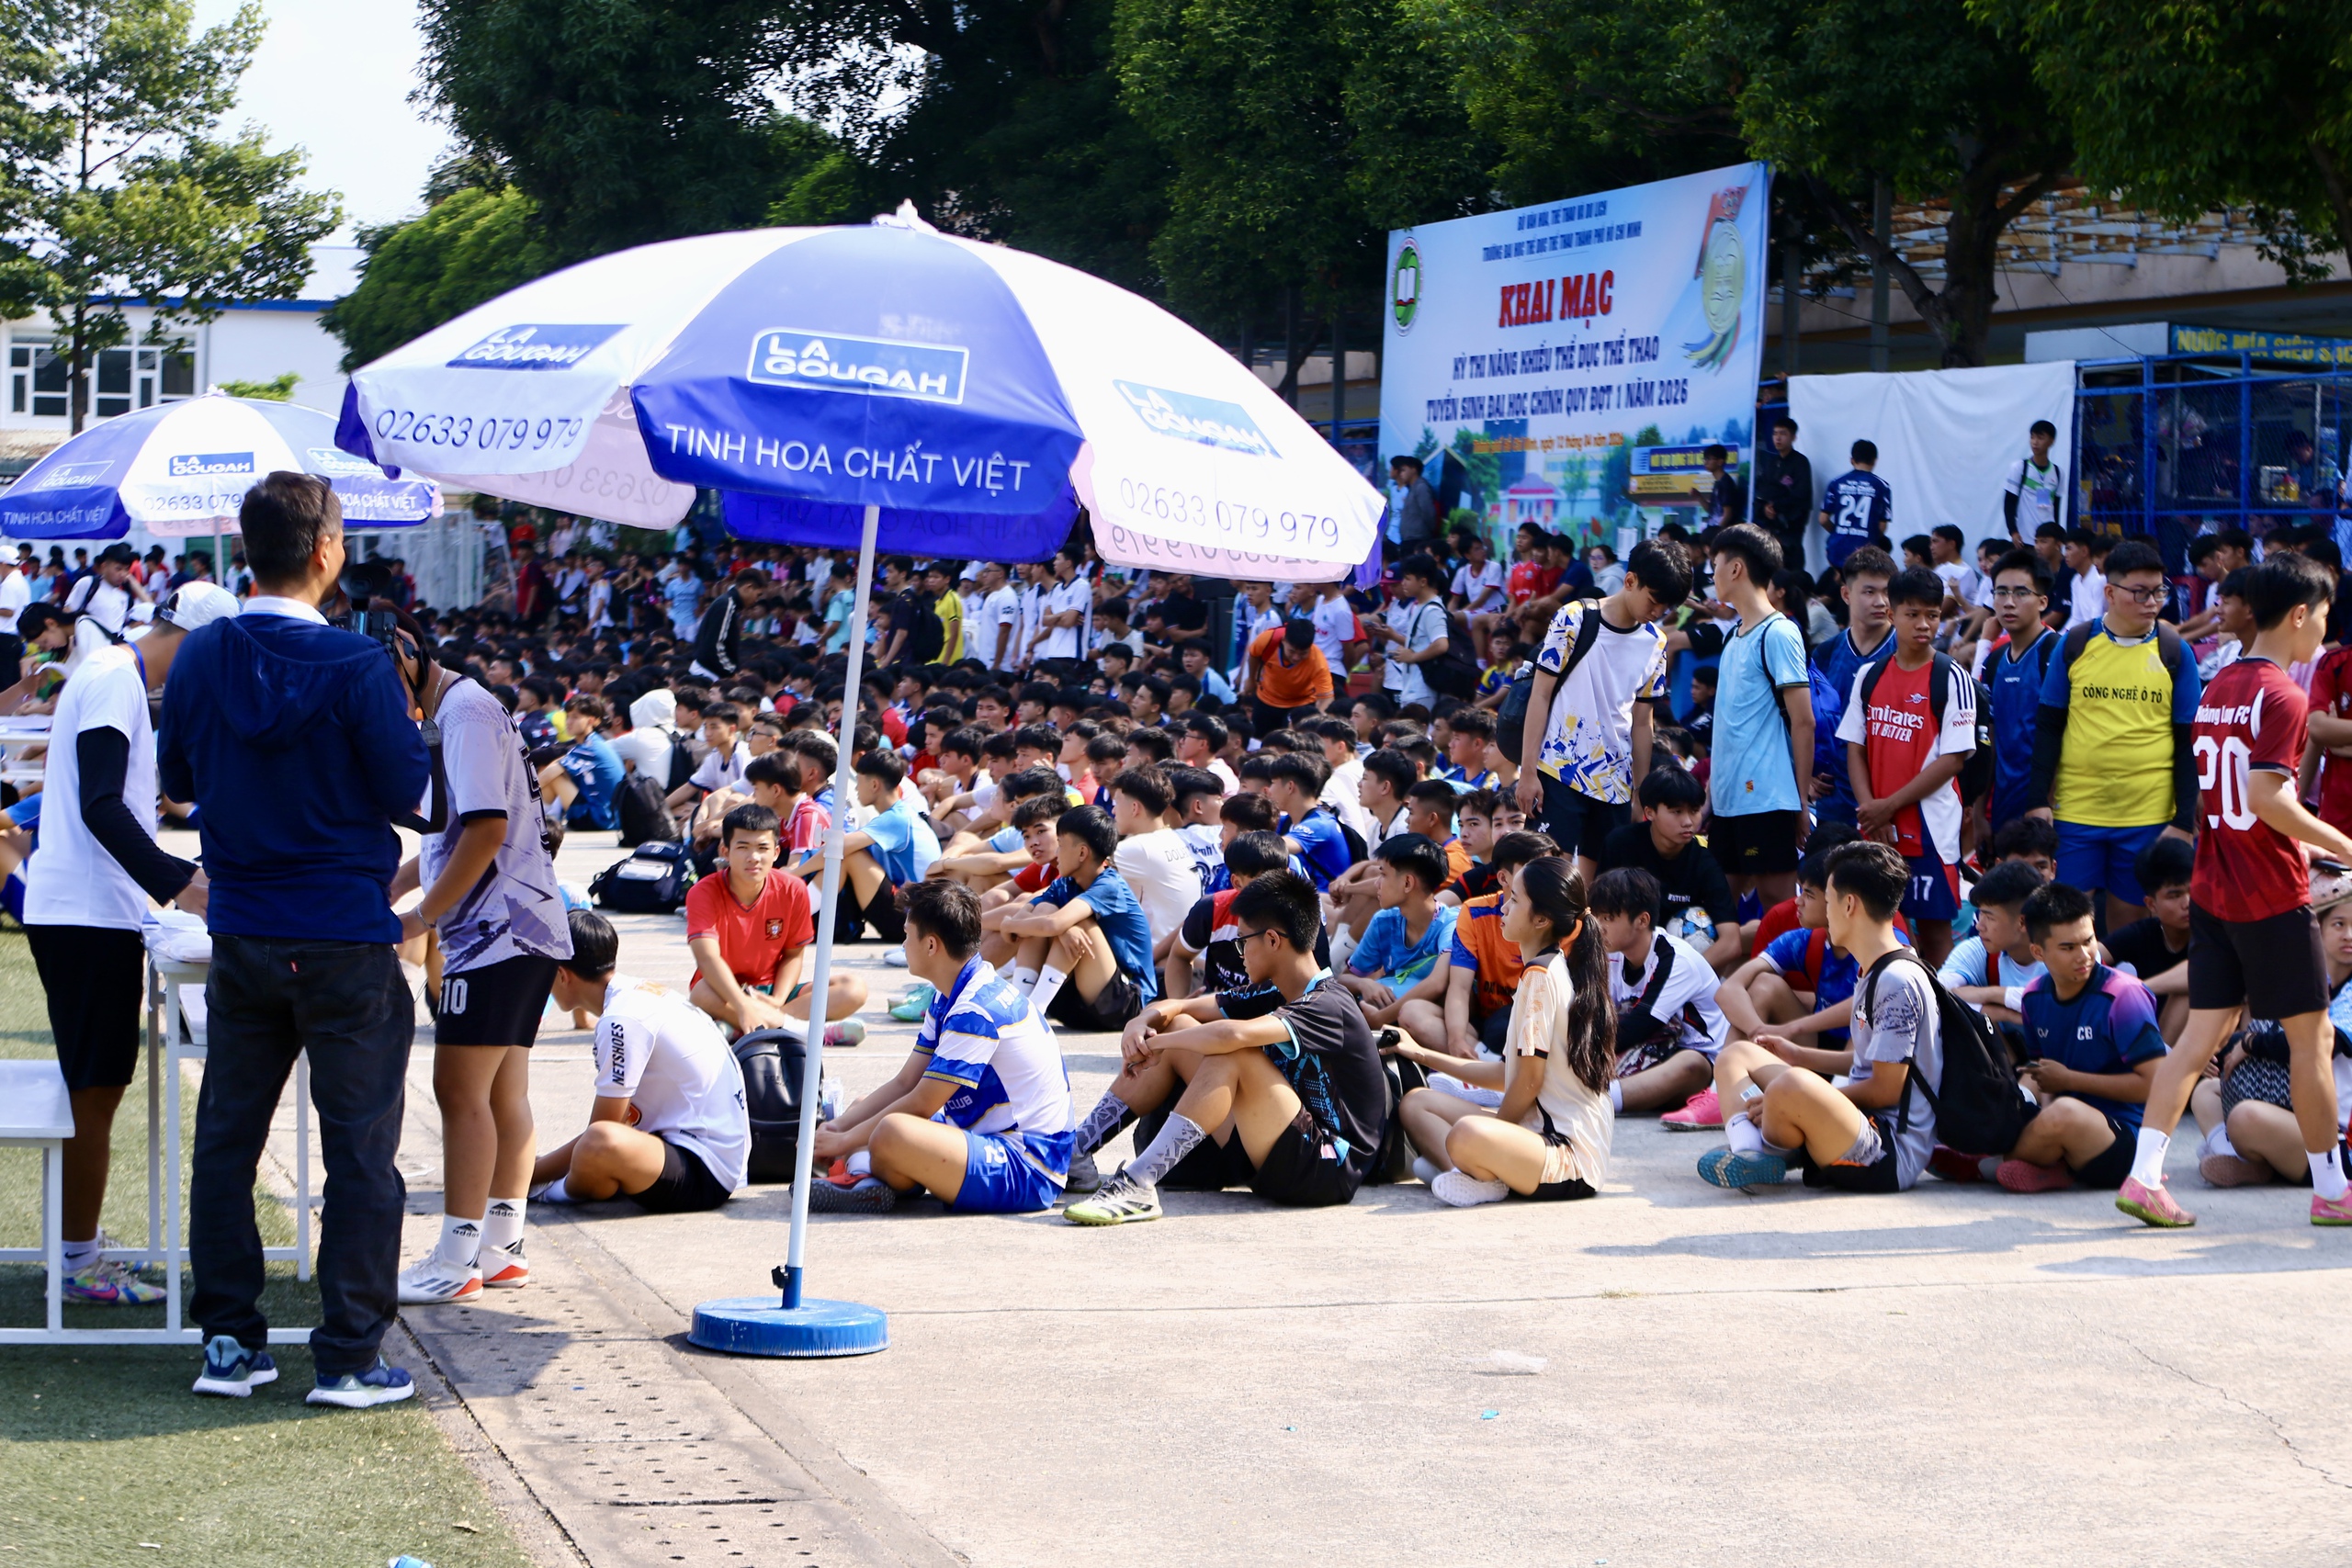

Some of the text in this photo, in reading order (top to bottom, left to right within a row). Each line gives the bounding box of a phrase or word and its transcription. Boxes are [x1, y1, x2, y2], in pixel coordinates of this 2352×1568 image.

[1498, 270, 1614, 329] KHAI MẠC
[487, 327, 538, 344] LA
[769, 335, 830, 361] LA
[464, 343, 591, 364] GOUGAH
[1469, 355, 1486, 378] THI
[1555, 334, 1577, 371] THỂ
[1578, 342, 1600, 373] DỤC
[1603, 329, 1626, 367] THỂ
[1628, 335, 1660, 364] THAO
[764, 355, 947, 396] GOUGAH
[1427, 388, 1459, 423] TUYỂN
[1460, 396, 1486, 421] SINH
[1531, 386, 1564, 415] CHÍNH
[1566, 387, 1589, 417] QUY
[1590, 384, 1613, 415] ĐỢT
[1616, 385, 1623, 410] 1
[1624, 377, 1656, 409] NĂM
[376, 410, 583, 451] 02633 079 979
[172, 462, 251, 475] GOUGAH
[173, 457, 200, 467] LA
[666, 423, 1031, 497] TINH HOA CHẤT VIỆT
[4, 511, 30, 525] TINH
[33, 510, 54, 525] HOA
[143, 496, 204, 512] 02633
[1120, 478, 1340, 547] 02633 079 979
[1838, 494, 1872, 529] 24
[2083, 683, 2163, 705] CÔNG NGHỆ Ô TÔ
[2233, 705, 2251, 726] FC
[2193, 736, 2257, 831] 20
[1913, 875, 1934, 901] 17
[443, 978, 468, 1014] 10
[2077, 1026, 2093, 1041] CB
[611, 1022, 625, 1086] NETSHOES
